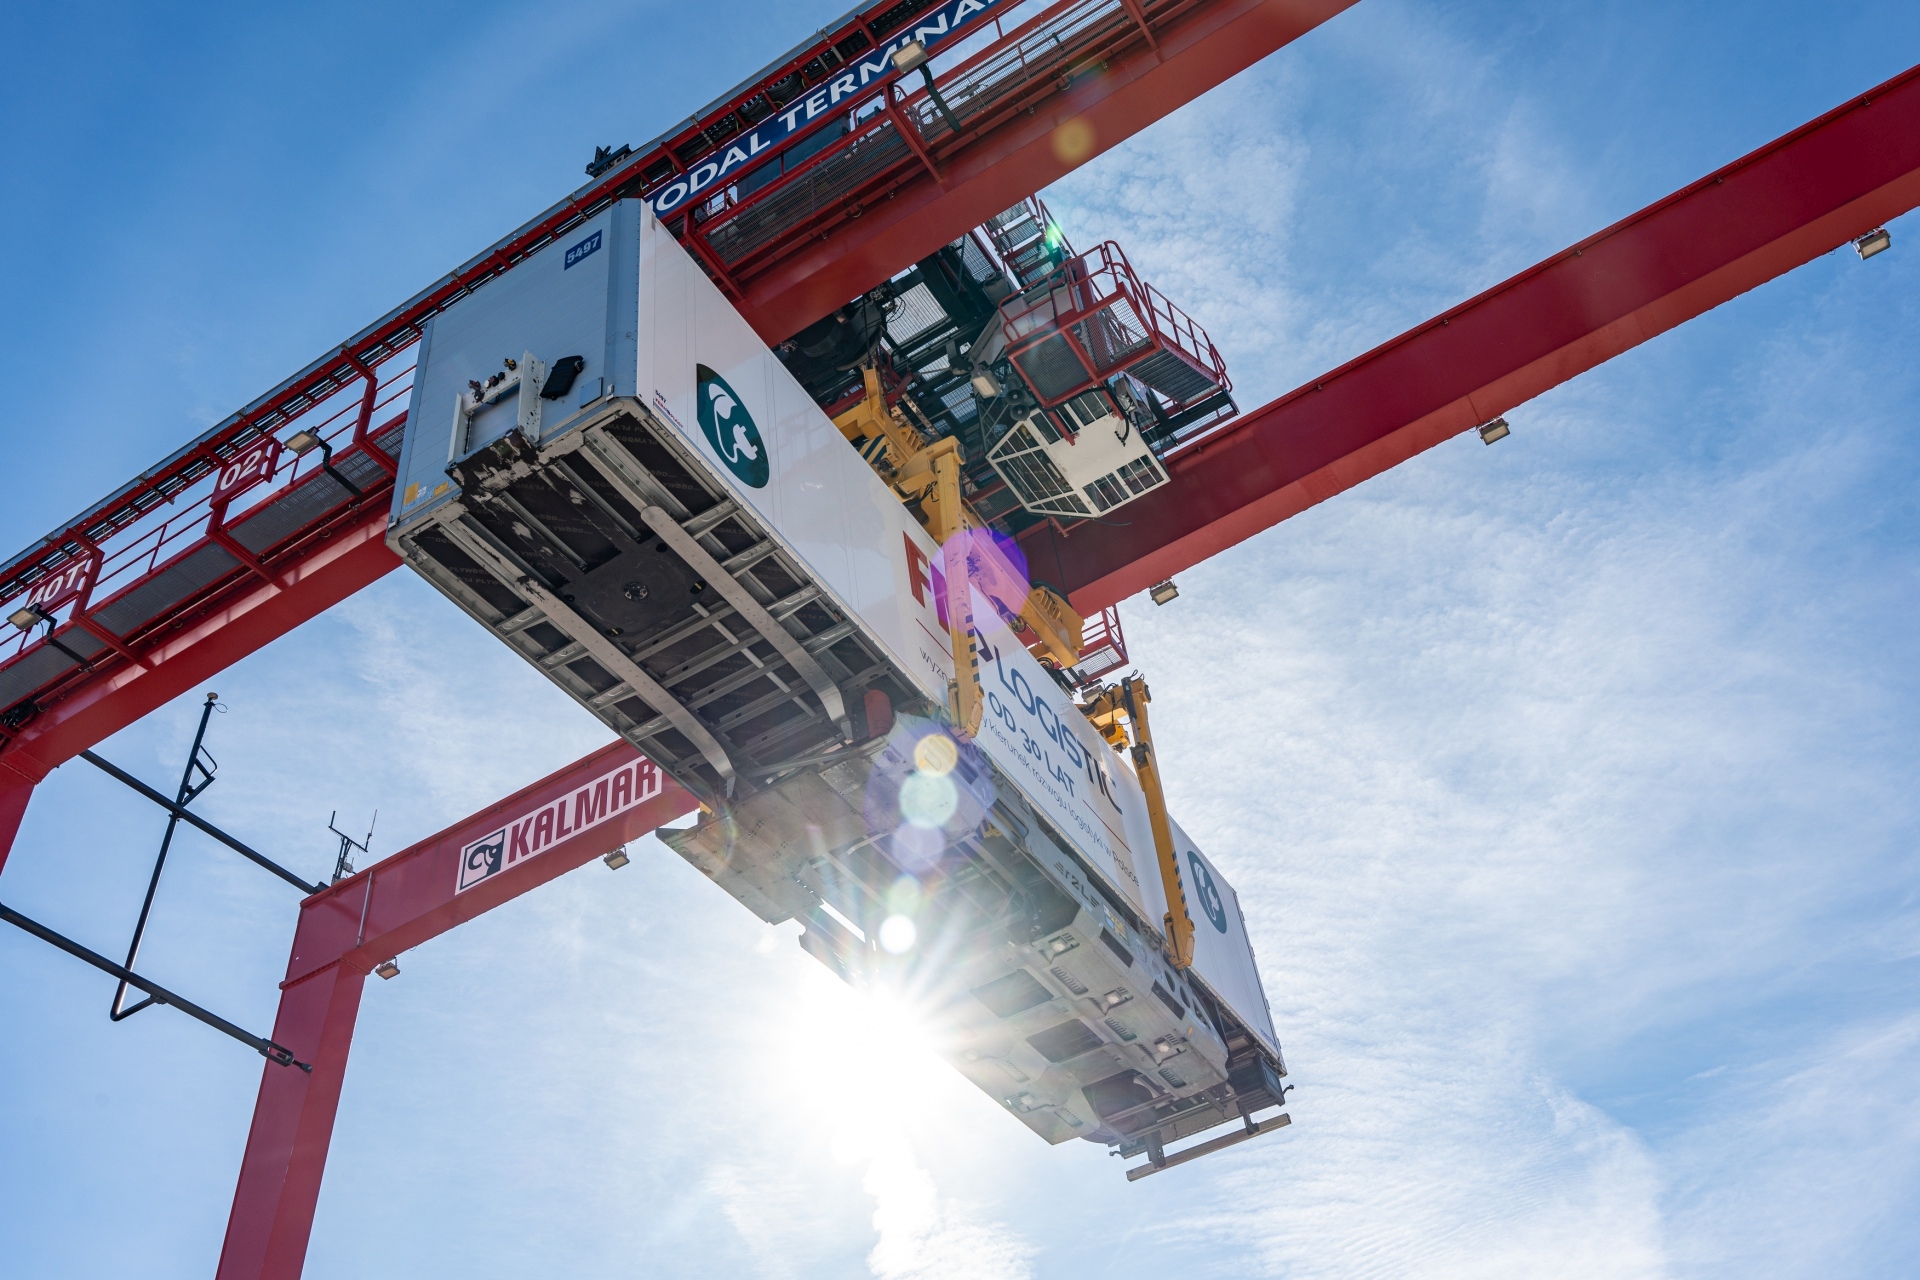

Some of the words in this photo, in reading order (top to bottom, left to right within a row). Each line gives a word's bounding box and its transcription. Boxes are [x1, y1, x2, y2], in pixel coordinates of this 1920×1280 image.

[647, 133, 771, 211] ODAL
[567, 235, 600, 264] 5497
[220, 450, 263, 491] 02
[988, 691, 1016, 733] OD
[1020, 728, 1041, 761] 30
[1044, 750, 1075, 798] LAT
[994, 645, 1123, 815] LOGISTIC
[508, 759, 657, 864] KALMAR
[1112, 850, 1139, 887] Polsce
